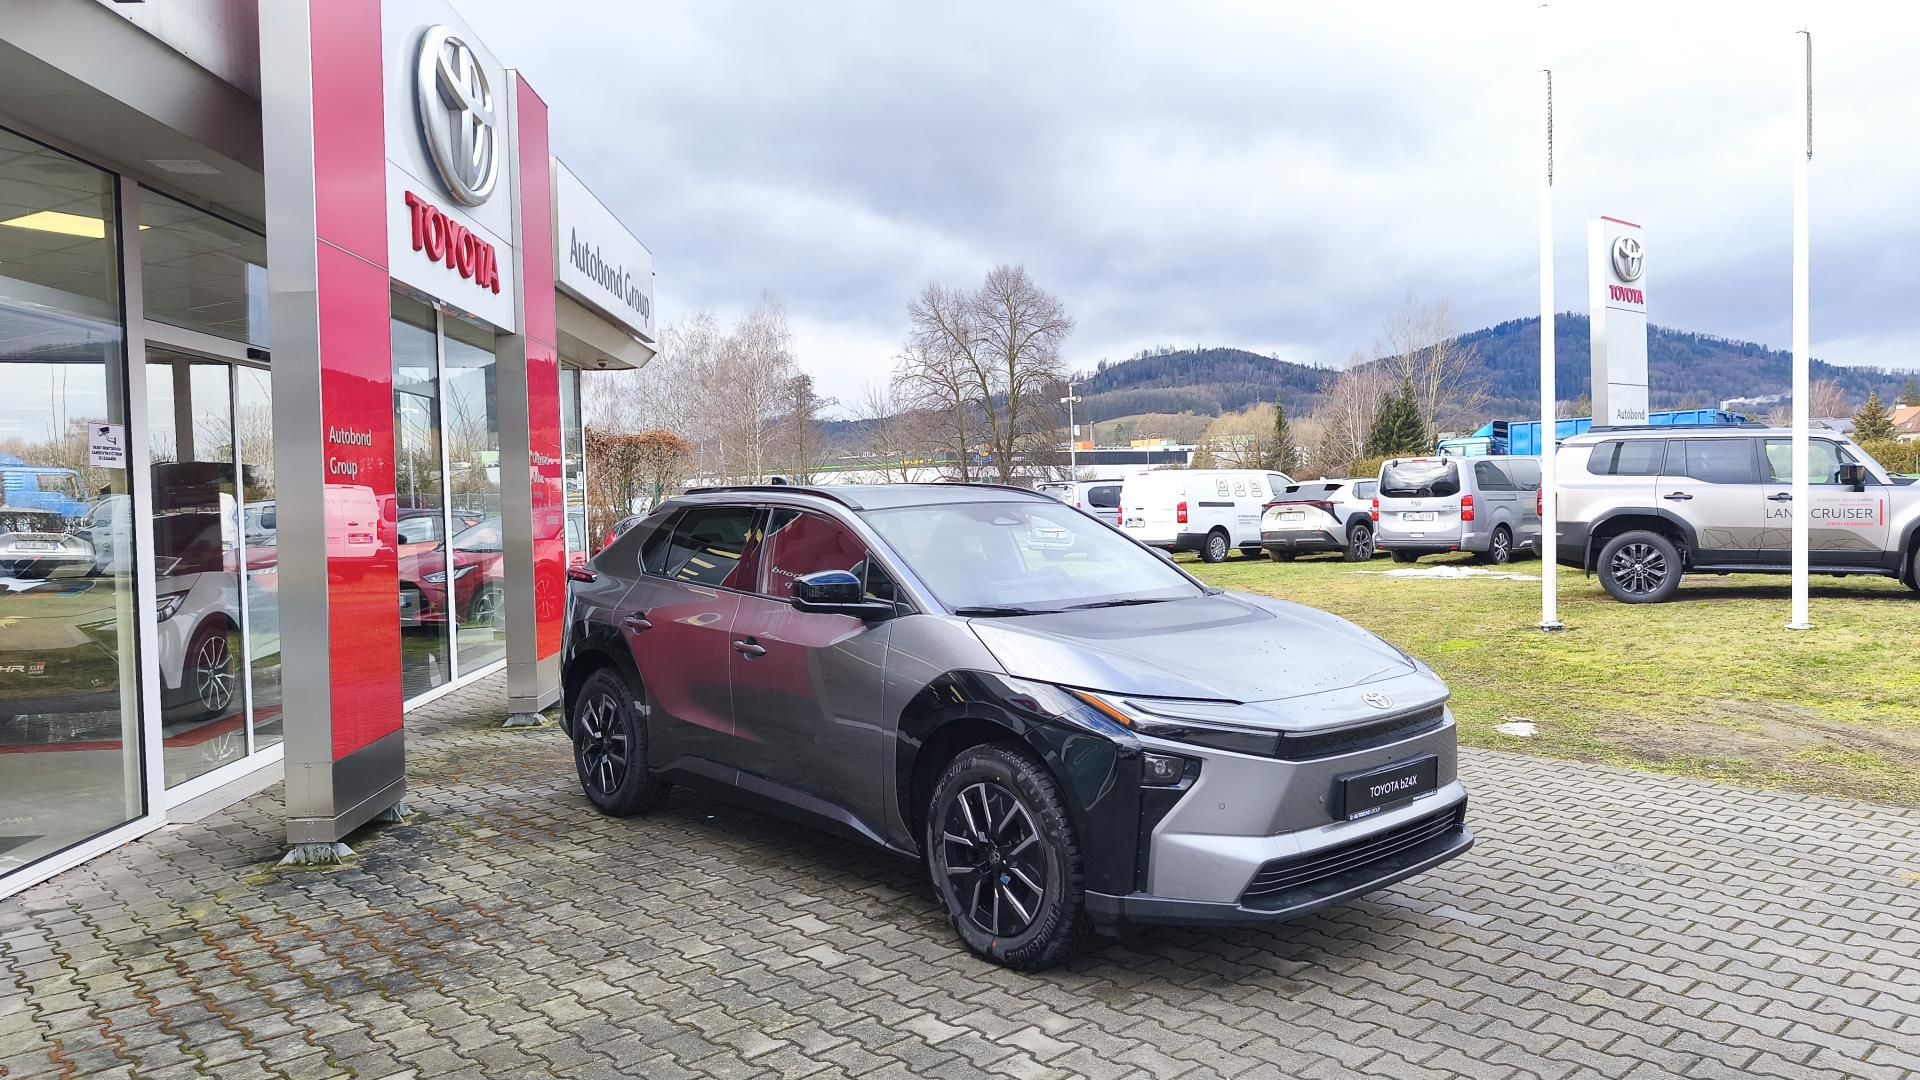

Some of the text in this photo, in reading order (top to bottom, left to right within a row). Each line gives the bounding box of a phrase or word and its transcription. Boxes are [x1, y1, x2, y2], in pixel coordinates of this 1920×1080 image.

[405, 191, 500, 295] TOYOTA
[570, 226, 650, 328] Autobond Group
[1609, 285, 1644, 304] TOYOTA
[1617, 408, 1645, 420] Autobond
[329, 425, 372, 446] Autobond
[329, 457, 357, 480] Group
[1766, 508, 1873, 519] LAN CRUISER
[1370, 775, 1417, 797] TOYOTA bZ4X
